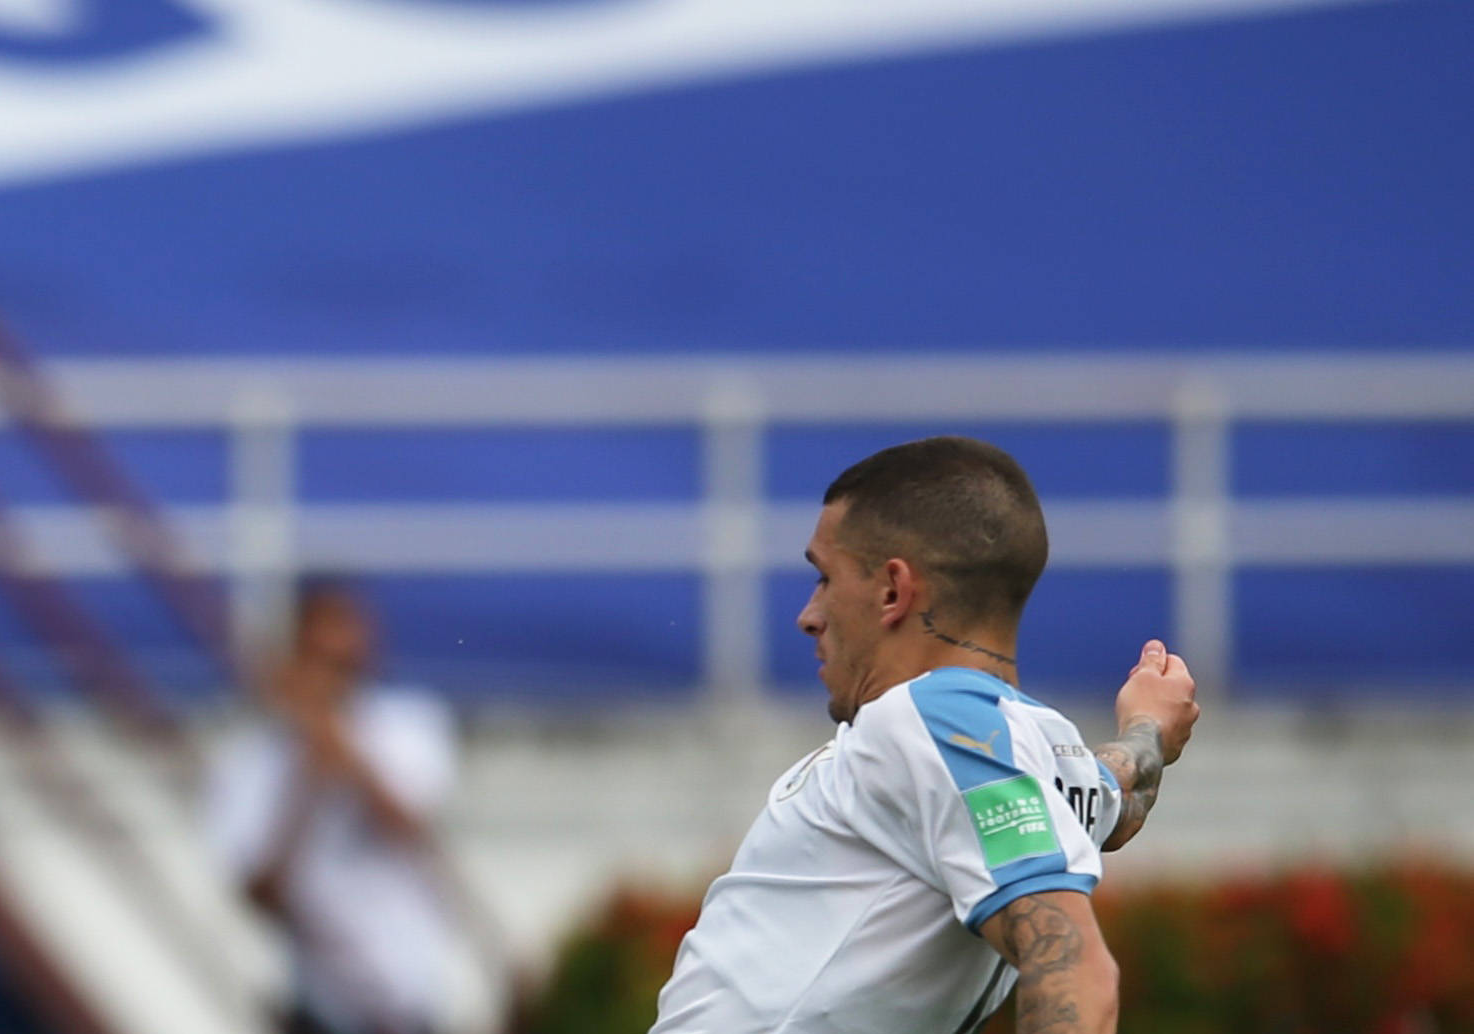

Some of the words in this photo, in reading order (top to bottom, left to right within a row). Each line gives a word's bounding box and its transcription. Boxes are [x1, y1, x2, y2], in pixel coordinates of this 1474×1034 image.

[976, 796, 1040, 820] LIVING
[979, 806, 1042, 829] FOOTBALL
[1018, 822, 1047, 835] FIFA
